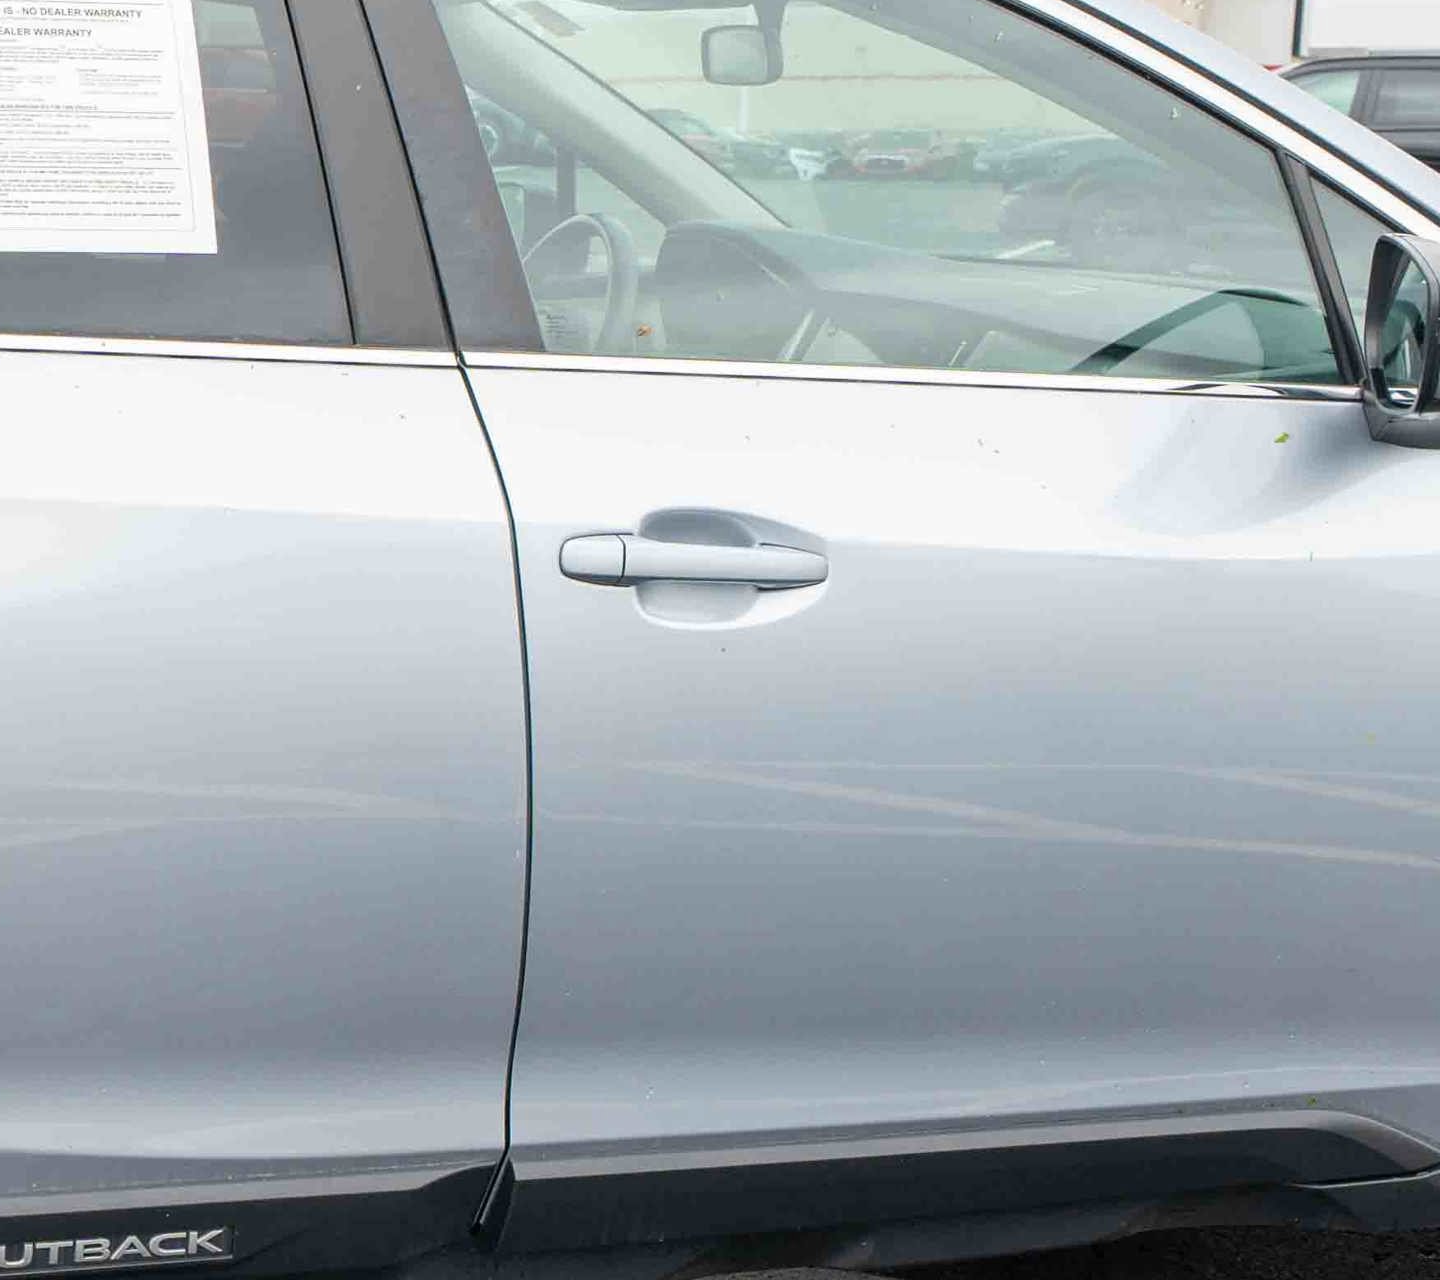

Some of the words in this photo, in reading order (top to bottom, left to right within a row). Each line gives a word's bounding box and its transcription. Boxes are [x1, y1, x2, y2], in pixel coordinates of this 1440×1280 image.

[22, 7, 37, 16] NO
[40, 7, 82, 17] DEALER
[84, 9, 142, 19] WARRANTY
[33, 28, 92, 38] WARRANTY
